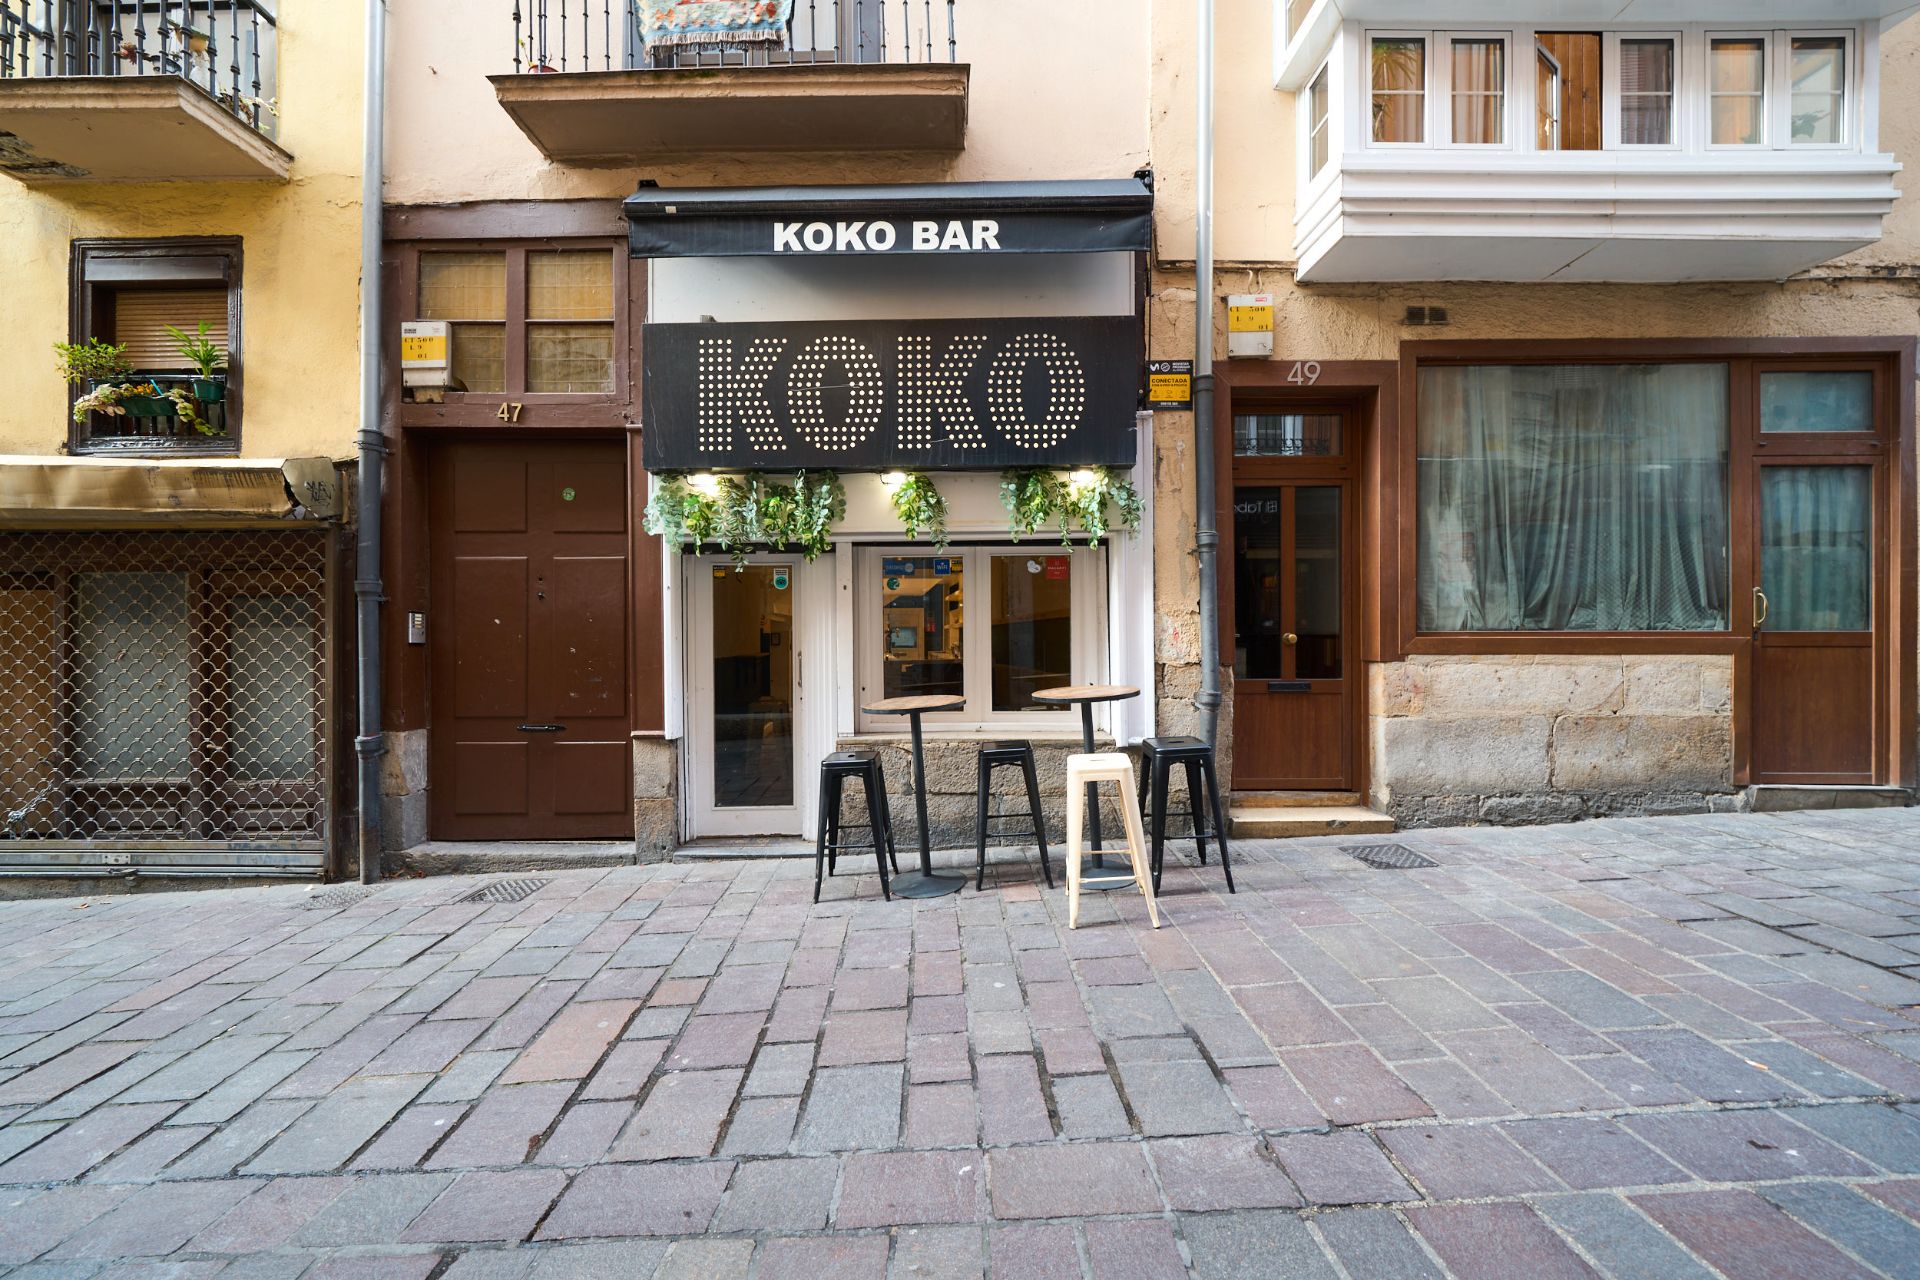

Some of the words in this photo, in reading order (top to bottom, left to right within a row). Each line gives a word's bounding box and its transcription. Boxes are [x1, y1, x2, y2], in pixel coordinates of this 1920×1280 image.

[773, 221, 896, 251] KOKO
[912, 220, 1001, 250] BAR
[1287, 361, 1321, 386] 49
[699, 333, 1086, 452] KOKO
[497, 402, 522, 422] 47
